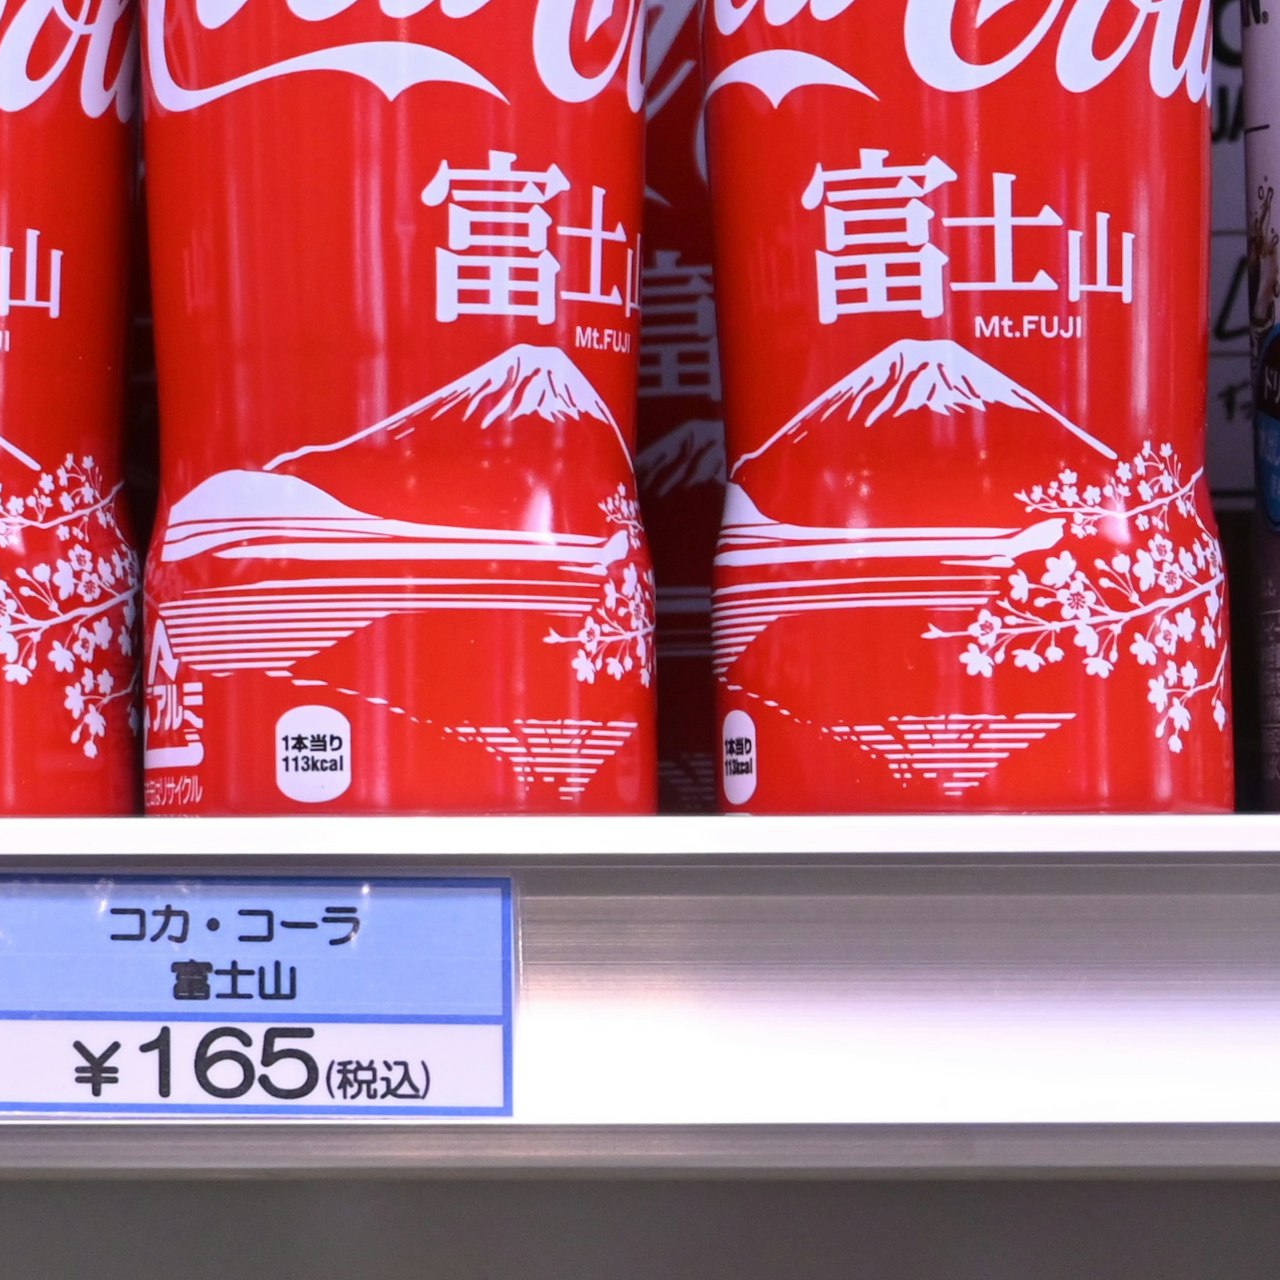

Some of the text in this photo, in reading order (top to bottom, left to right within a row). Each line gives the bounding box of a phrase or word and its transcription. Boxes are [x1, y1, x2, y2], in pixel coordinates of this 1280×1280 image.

[801, 148, 1136, 325] 富士山
[575, 325, 631, 354] Mt.FUJI
[974, 314, 1083, 339] Mt.FUJI
[153, 681, 204, 733] アルミ
[282, 733, 344, 753] 1本当り
[282, 755, 344, 773] 113kcal
[110, 903, 360, 946] コカ・コーラ
[171, 960, 297, 1000] 富士山
